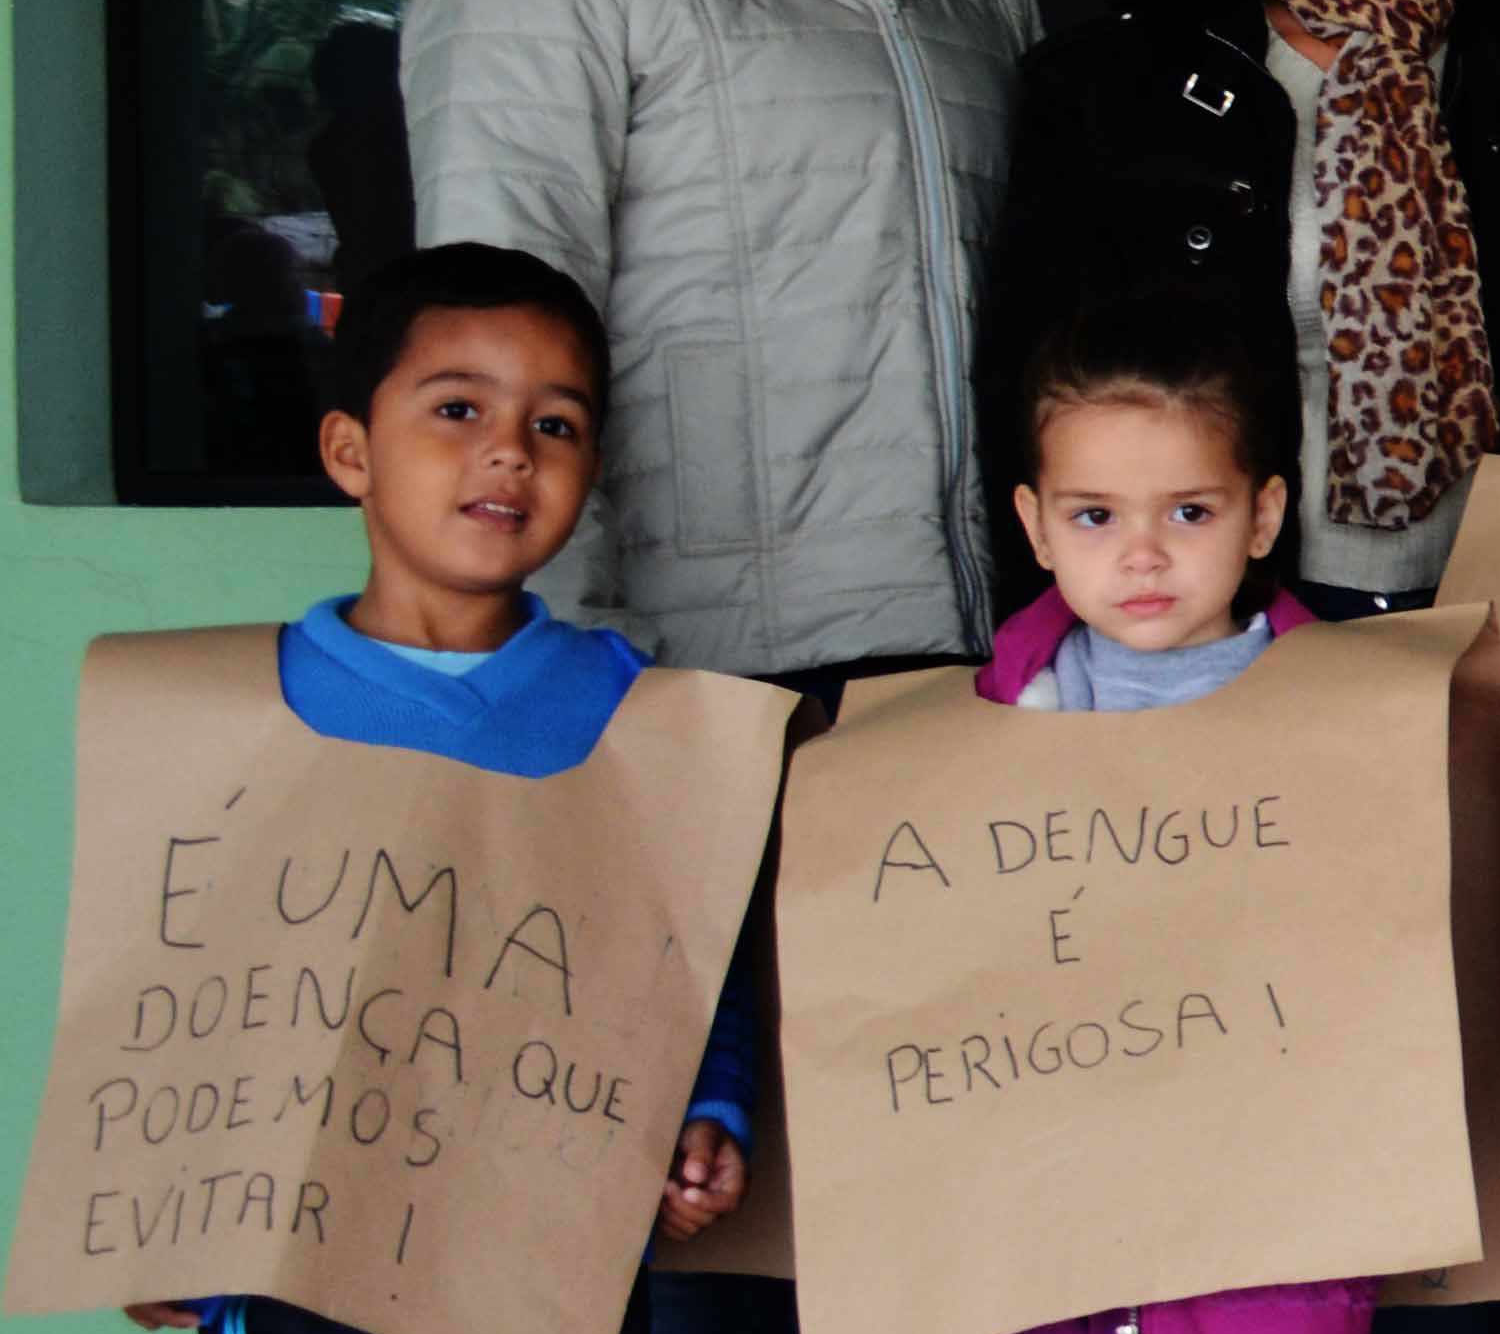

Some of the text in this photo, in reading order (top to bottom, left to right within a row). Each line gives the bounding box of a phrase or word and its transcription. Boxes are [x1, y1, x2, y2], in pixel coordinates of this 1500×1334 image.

[159, 785, 573, 1017] É UMA
[872, 794, 1291, 904] A DENGUE
[1047, 884, 1087, 965] É
[118, 962, 635, 1125] DOENÇA QUE
[885, 990, 1230, 1114] PERIGOSA
[87, 1073, 447, 1170] PODEMOS
[83, 1166, 331, 1257] EVITAR
